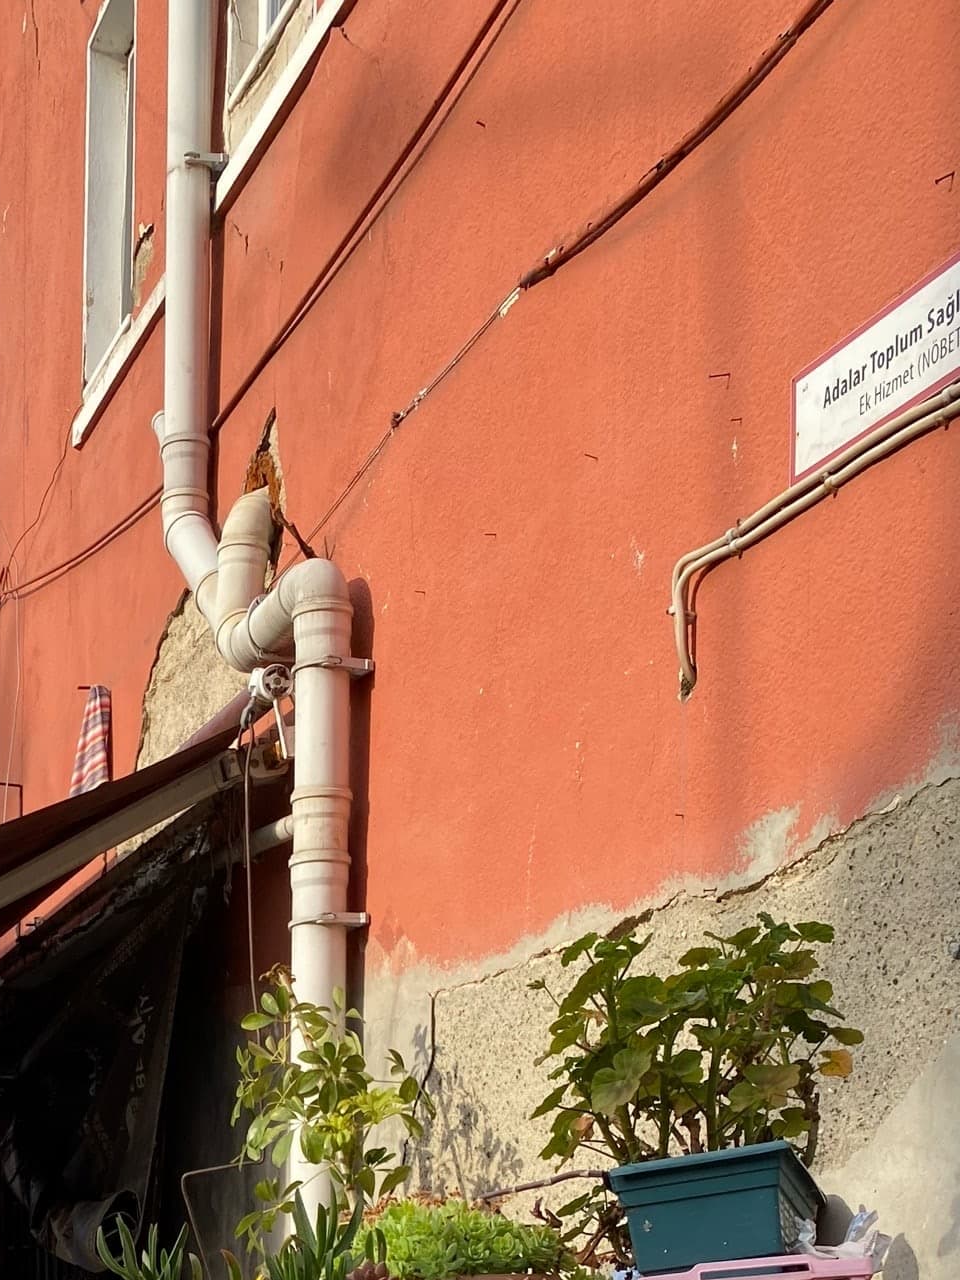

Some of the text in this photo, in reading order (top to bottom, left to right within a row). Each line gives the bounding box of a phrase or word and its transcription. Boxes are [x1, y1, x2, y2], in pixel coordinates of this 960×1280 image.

[823, 288, 960, 409] Adalar Toplum Sağl
[858, 394, 872, 416] Ek
[874, 363, 915, 405] Hizmet
